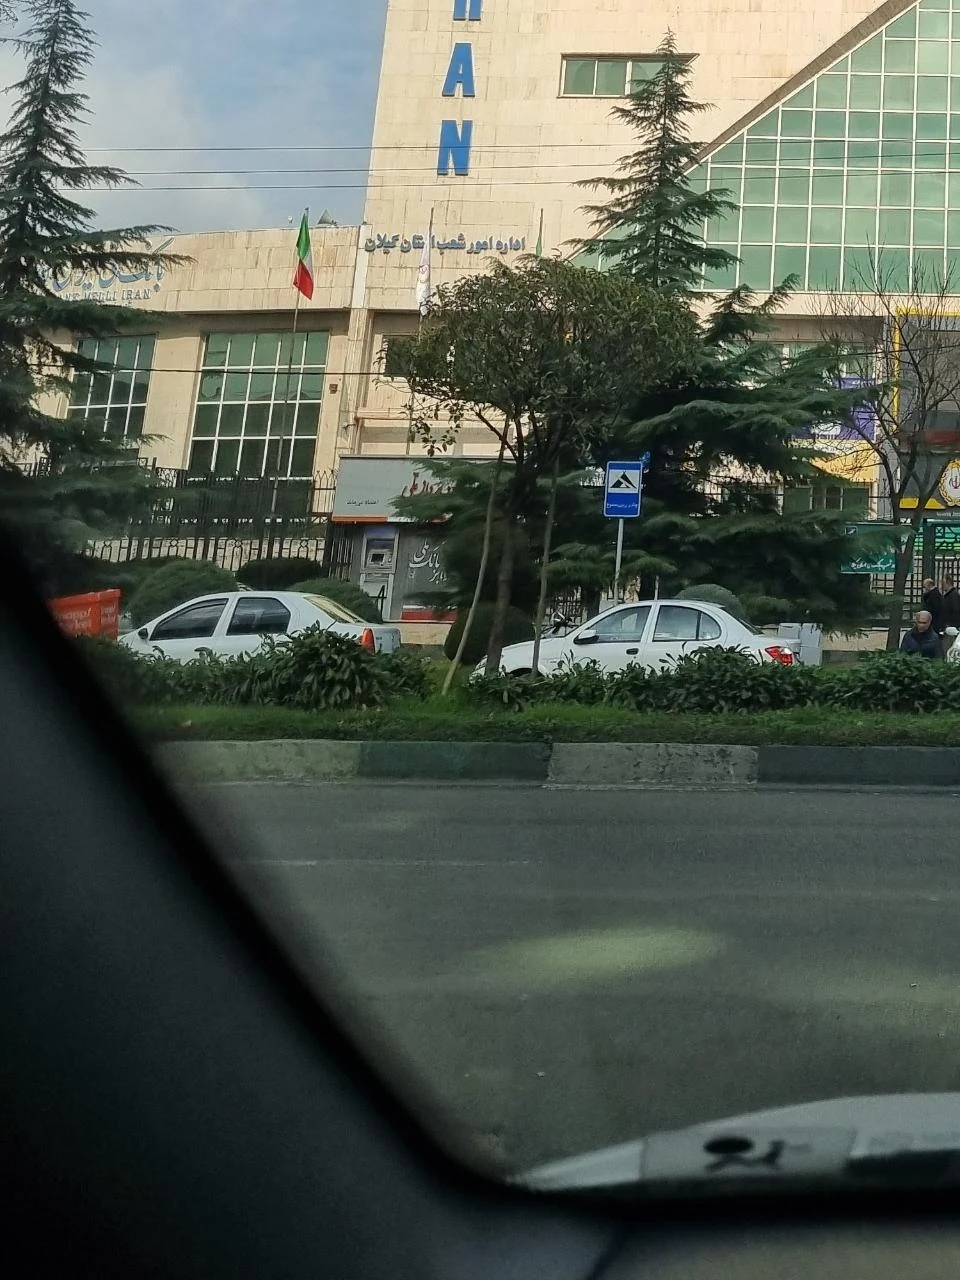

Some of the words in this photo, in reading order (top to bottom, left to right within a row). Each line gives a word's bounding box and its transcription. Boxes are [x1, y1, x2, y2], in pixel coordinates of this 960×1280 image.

[364, 232, 400, 255] گیلان
[400, 233, 436, 253] اتان
[436, 232, 466, 256] شعب
[466, 235, 493, 254] امور
[495, 235, 527, 254] اداره
[121, 288, 152, 301] IRAN
